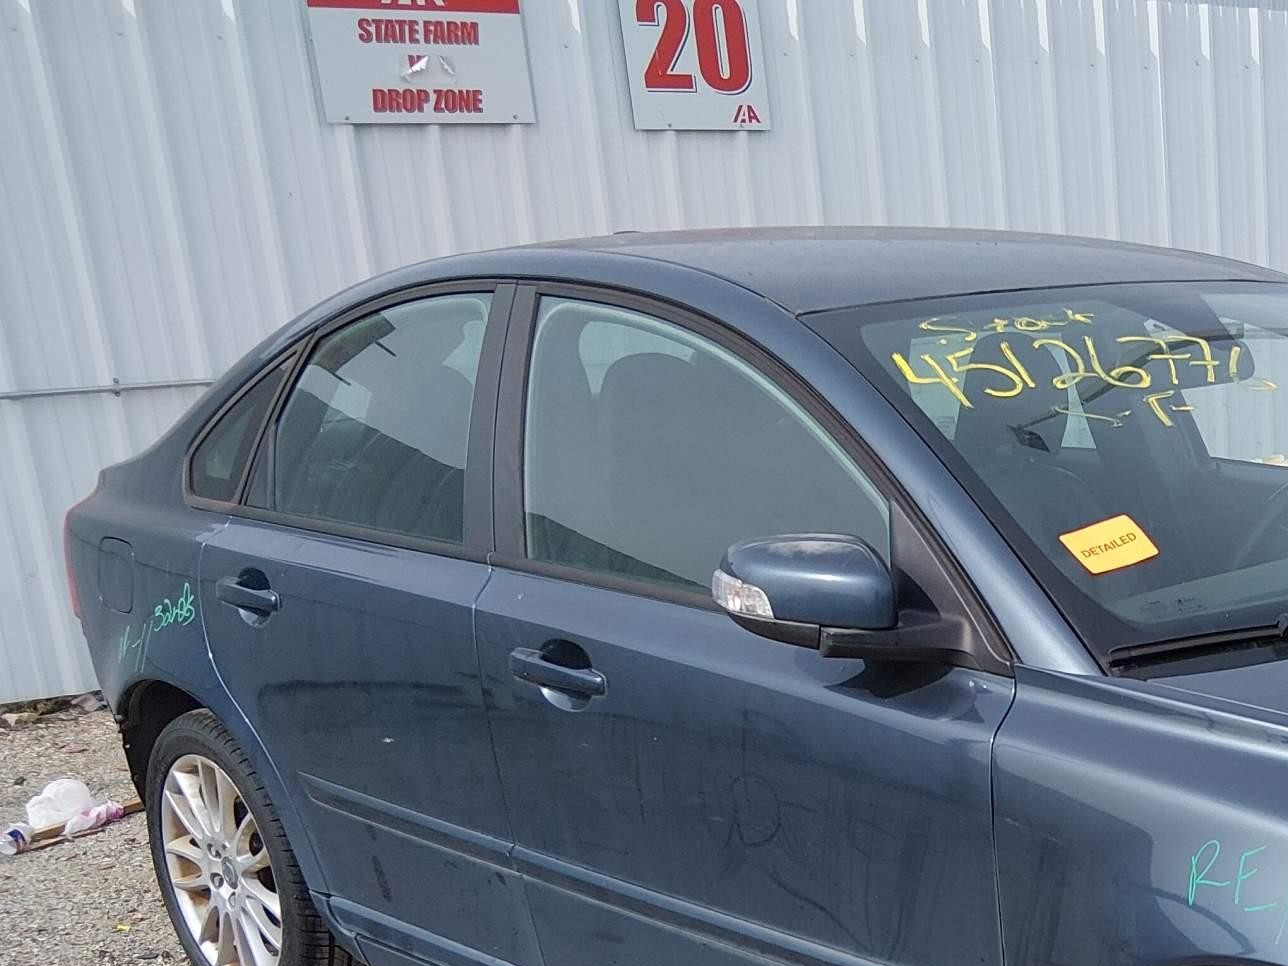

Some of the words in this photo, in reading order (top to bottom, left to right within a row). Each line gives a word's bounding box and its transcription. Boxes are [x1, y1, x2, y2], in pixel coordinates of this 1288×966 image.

[357, 18, 421, 44] STATE
[423, 20, 480, 46] FARM
[635, 0, 754, 94] 20
[372, 88, 430, 114] DROP
[433, 89, 484, 114] ZONE
[1080, 532, 1138, 559] DETAILED
